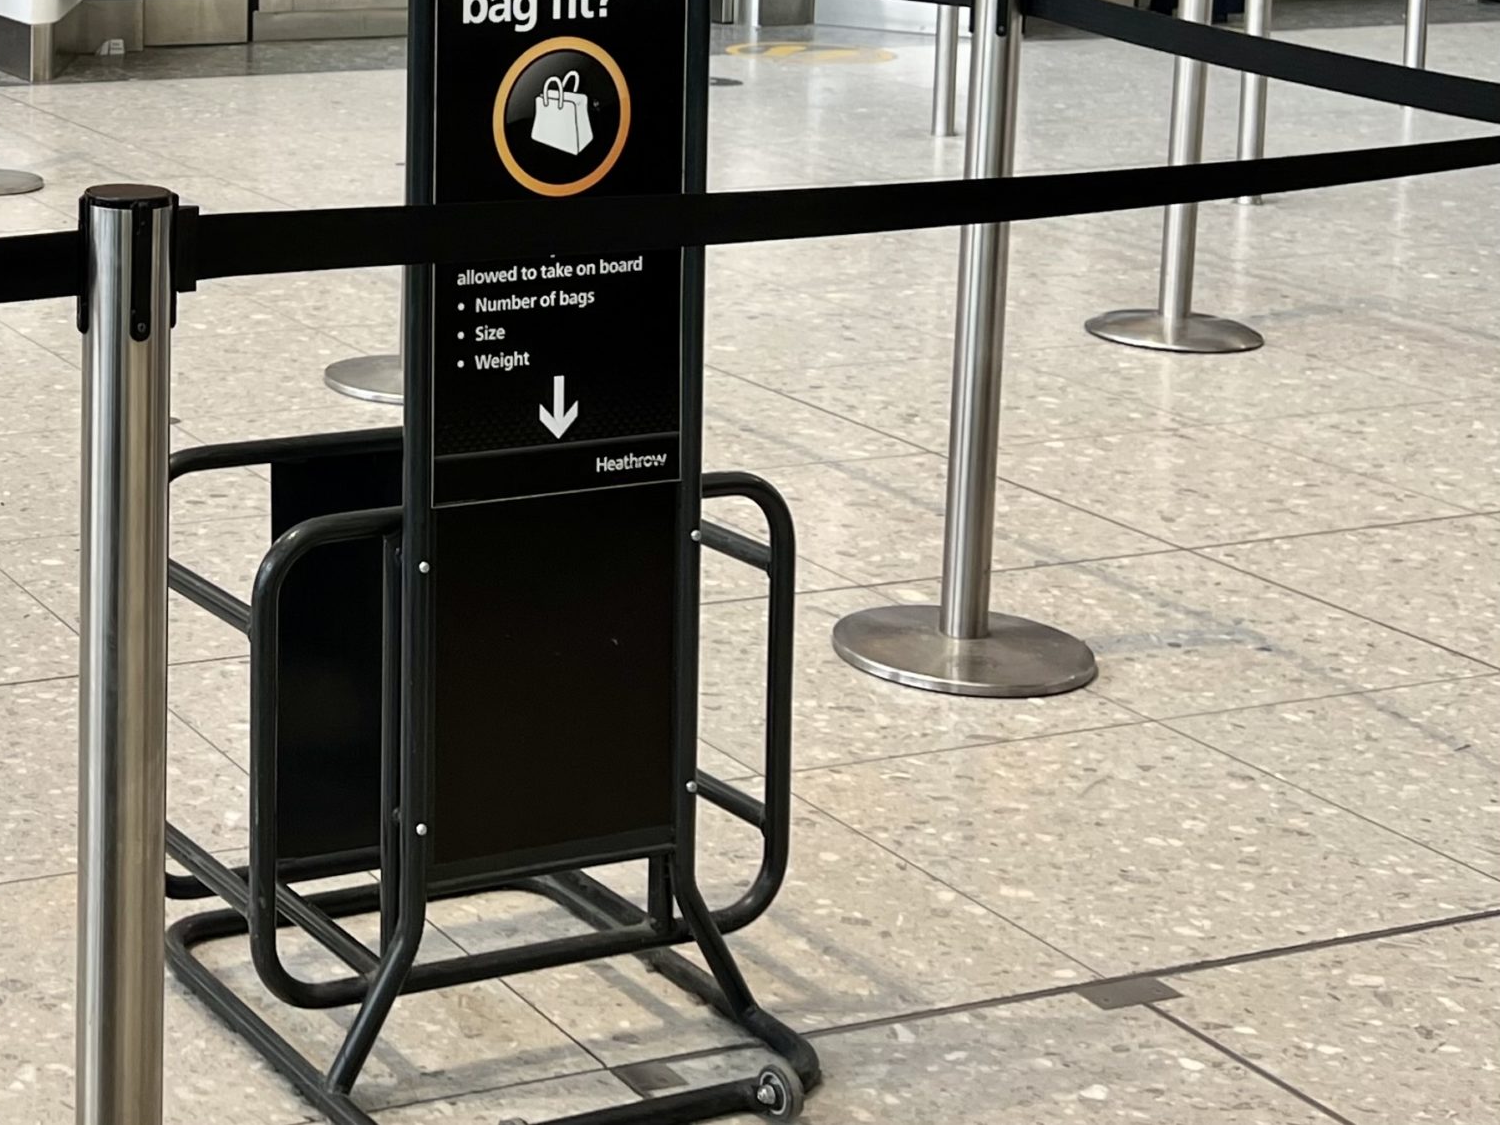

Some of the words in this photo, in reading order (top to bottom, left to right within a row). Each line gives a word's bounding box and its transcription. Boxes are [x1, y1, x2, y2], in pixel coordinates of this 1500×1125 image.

[457, 266, 517, 286] allowed
[521, 267, 537, 281] to
[540, 262, 573, 279] take
[576, 262, 596, 276] on
[599, 256, 643, 274] board
[475, 293, 537, 313] Number
[539, 291, 557, 308] of
[559, 289, 595, 308] bags
[475, 326, 505, 342] Size
[475, 351, 530, 371] Weight
[596, 452, 667, 473] Heathrow
